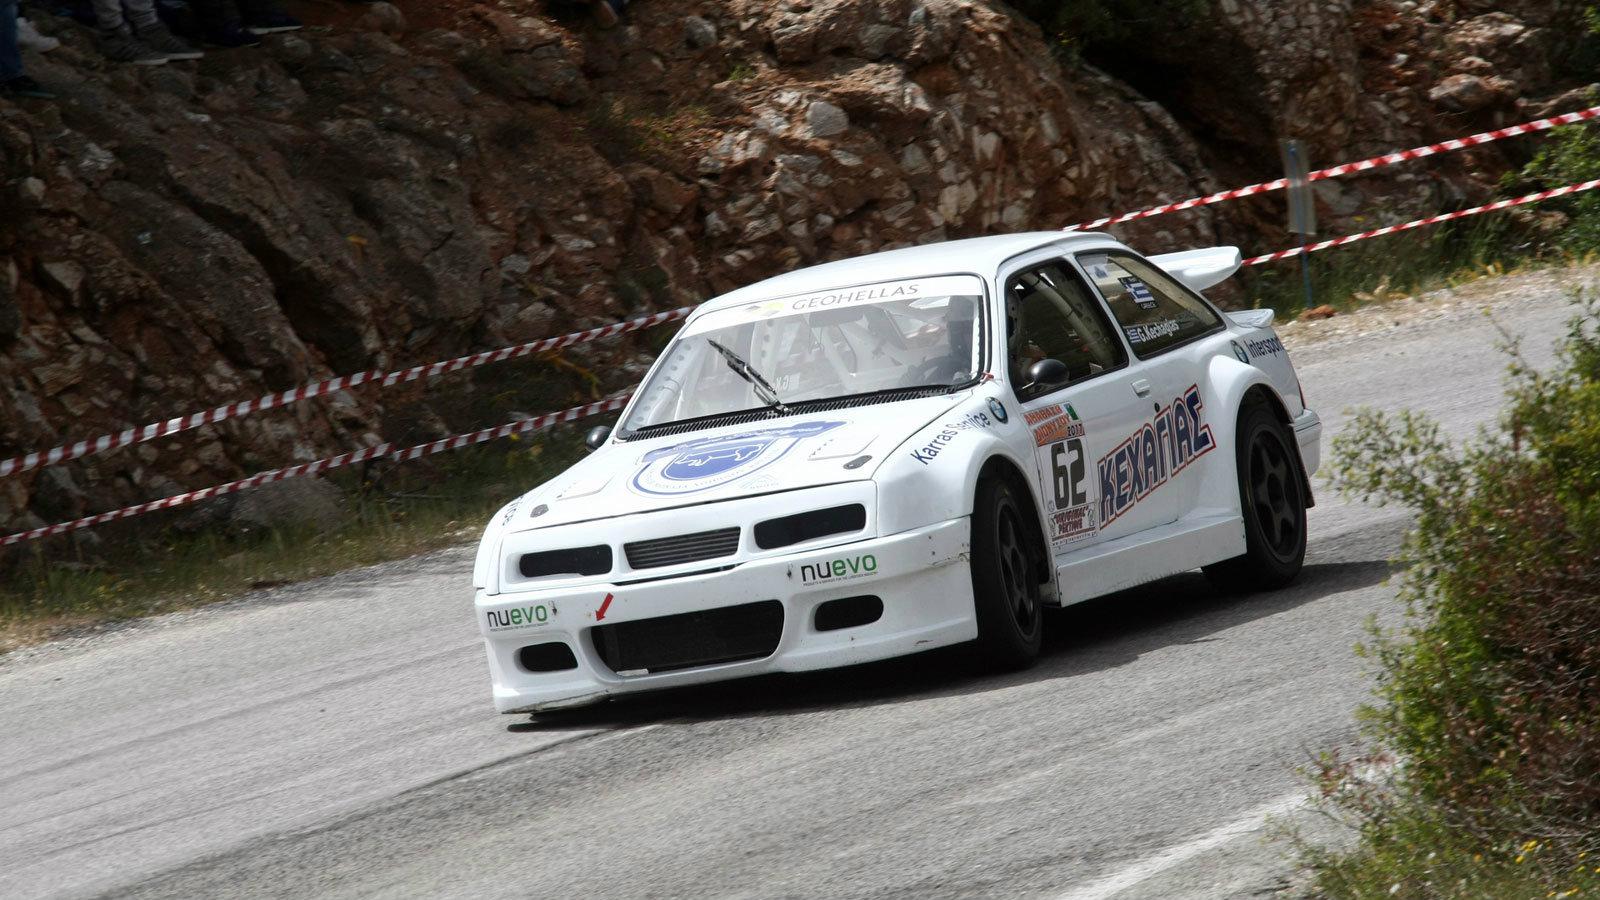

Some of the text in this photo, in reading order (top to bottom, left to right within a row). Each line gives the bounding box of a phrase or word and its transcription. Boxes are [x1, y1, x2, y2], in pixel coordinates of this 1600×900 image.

[792, 284, 920, 310] GEOHELLAS
[1136, 319, 1180, 342] G.Kechagias
[1067, 423, 1085, 437] 2017
[910, 429, 958, 466] Karras
[1051, 438, 1087, 510] 62
[801, 554, 877, 582] nuevo
[487, 605, 548, 627] nuevo
